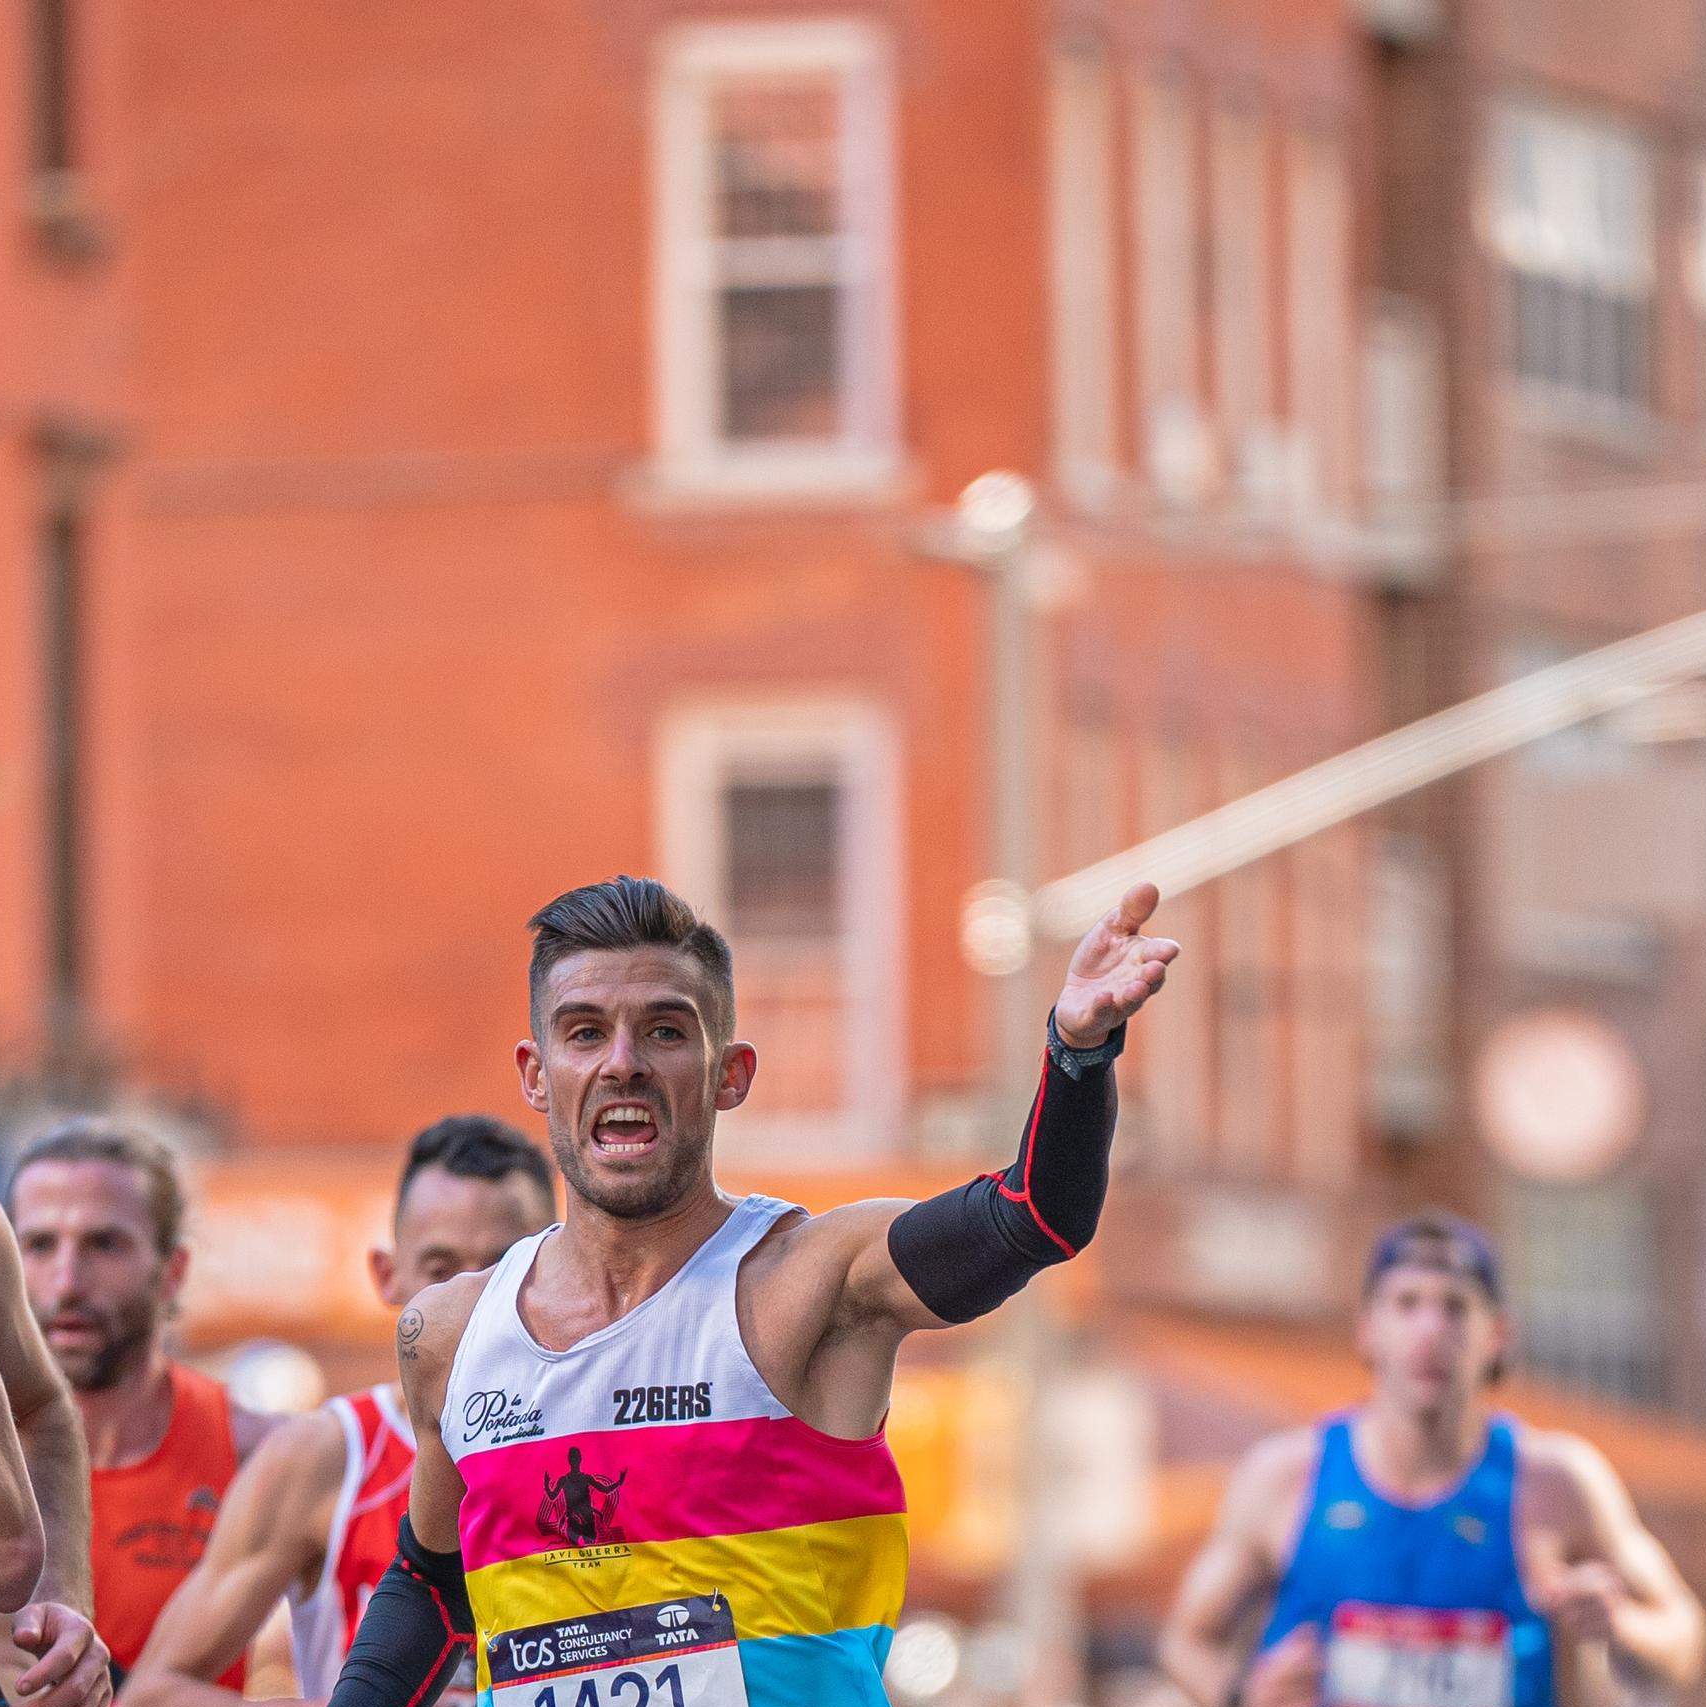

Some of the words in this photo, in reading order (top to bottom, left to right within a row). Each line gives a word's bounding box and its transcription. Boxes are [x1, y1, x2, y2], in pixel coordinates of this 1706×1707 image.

[613, 1382, 712, 1425] 226ERS
[463, 1388, 543, 1442] Portada
[544, 1551, 571, 1562] JAVI
[579, 1545, 631, 1558] GUERRA
[556, 1624, 588, 1637] TATA
[558, 1628, 632, 1650] CONSULTANCY
[655, 1628, 699, 1646] TATA
[509, 1637, 555, 1671] tcs
[560, 1645, 608, 1663] SERVICES
